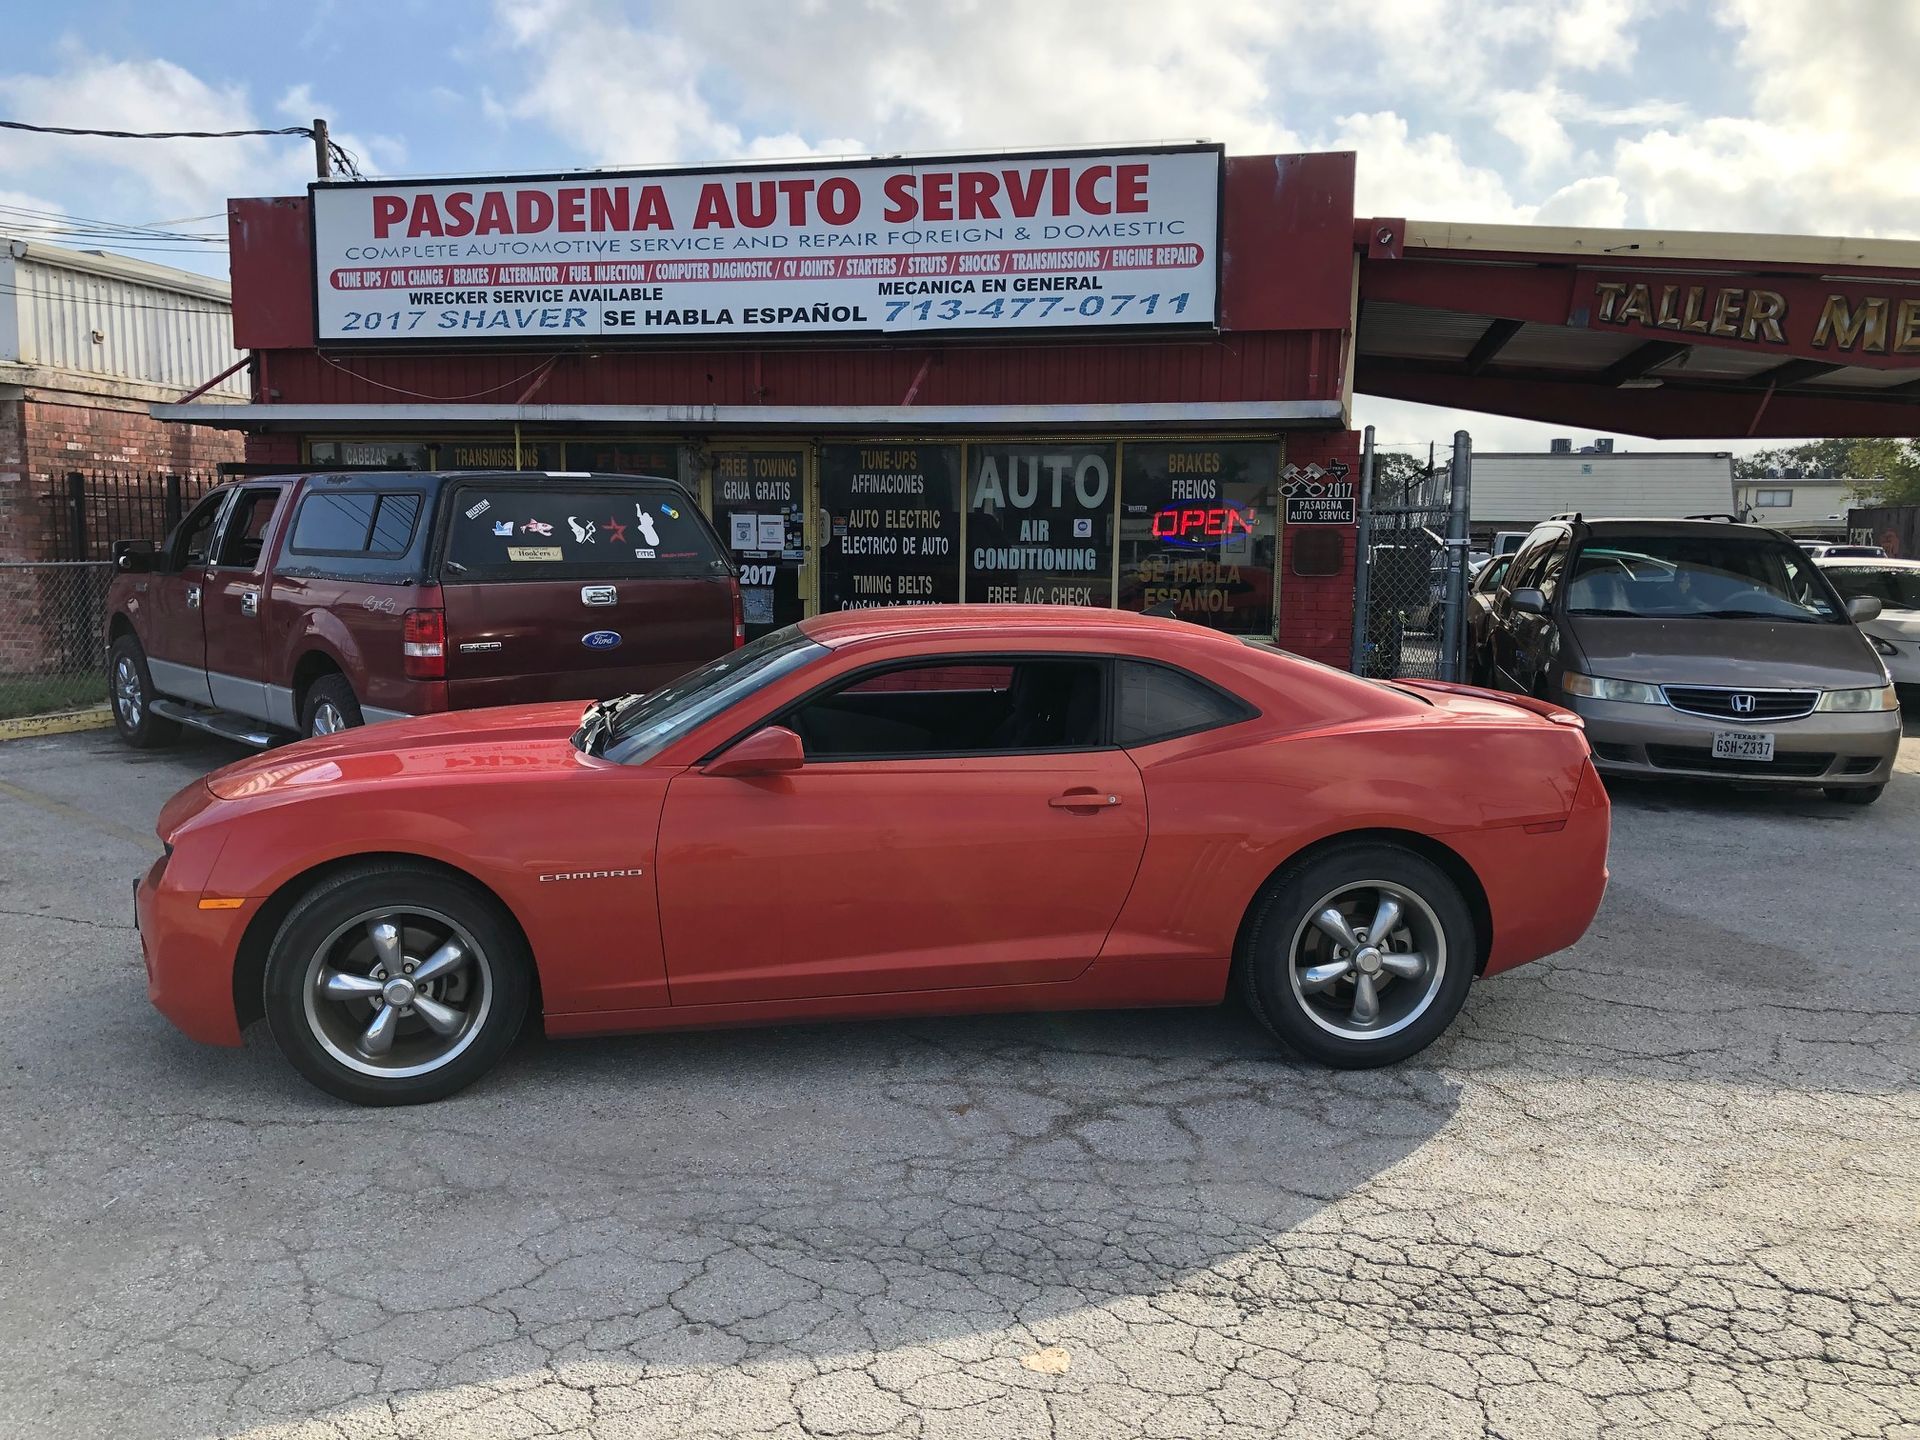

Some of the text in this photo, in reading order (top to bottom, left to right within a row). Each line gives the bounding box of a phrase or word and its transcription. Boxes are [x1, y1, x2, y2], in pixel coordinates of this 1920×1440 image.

[372, 164, 1149, 239] PASADENA AUTO SERVICE
[345, 220, 1185, 260] COMPLETE AUTOMOTIVE SERVICE AND REPAIR FOREIGN & DOMESTIC
[337, 271, 361, 288] TUNE
[364, 270, 381, 287] UPS
[391, 270, 406, 286] OIL
[408, 268, 444, 286] CHANGE
[453, 267, 489, 285] BRAKES
[499, 266, 558, 284] ALTERNATOR
[569, 264, 592, 282] FUEL
[594, 263, 644, 281] INJECTION
[656, 262, 710, 280] COMPUTER
[712, 261, 772, 279] DIAGNOSTIC
[783, 260, 797, 277] CV
[798, 259, 835, 277] JOINTS
[846, 257, 897, 276] STARTERS
[908, 255, 947, 274] STRUTS
[958, 254, 1000, 273] SHOCKS
[1012, 250, 1100, 270] TRANSMISSIONS
[1112, 248, 1153, 267] ENGINE
[1156, 246, 1198, 266] REPAIR
[878, 276, 1103, 295] MECANICA EN GENERAL
[409, 287, 663, 305] WRECKER SERVICE AVAILABLE
[341, 292, 1190, 331] 2017 SHAVER SE HABLA ESPAÑOL 713-477-0711
[1596, 281, 1788, 344] TALLER
[346, 447, 387, 465] CABEZAS
[860, 450, 917, 470] TUNE-UPS
[1168, 453, 1220, 473] BRAKES
[719, 457, 797, 478] FREE TOWING
[724, 481, 790, 501] GRUA GRATIS
[851, 474, 924, 494] AFFINACIONES
[972, 454, 1109, 509] AUTO
[1172, 479, 1216, 500] FRENOS
[1327, 482, 1353, 498] 2017
[1290, 510, 1350, 520] AUTO SERVICE
[1300, 500, 1342, 510] PASADENA
[848, 509, 879, 529] AUTO
[885, 509, 940, 529] ELECTRIC
[1151, 508, 1255, 536] OPEN
[1019, 519, 1050, 541] AIR
[841, 536, 949, 555] ELECTRICO DE AUTO
[973, 547, 1097, 571] CONDITIONING
[739, 564, 776, 585] 2017
[1139, 559, 1241, 584] SE HABLA
[853, 575, 933, 594] TIMING BELTS
[988, 586, 1092, 606] FREE A/C CHECK
[1733, 733, 1757, 741] TEXAS
[539, 869, 642, 881] CAMARO
